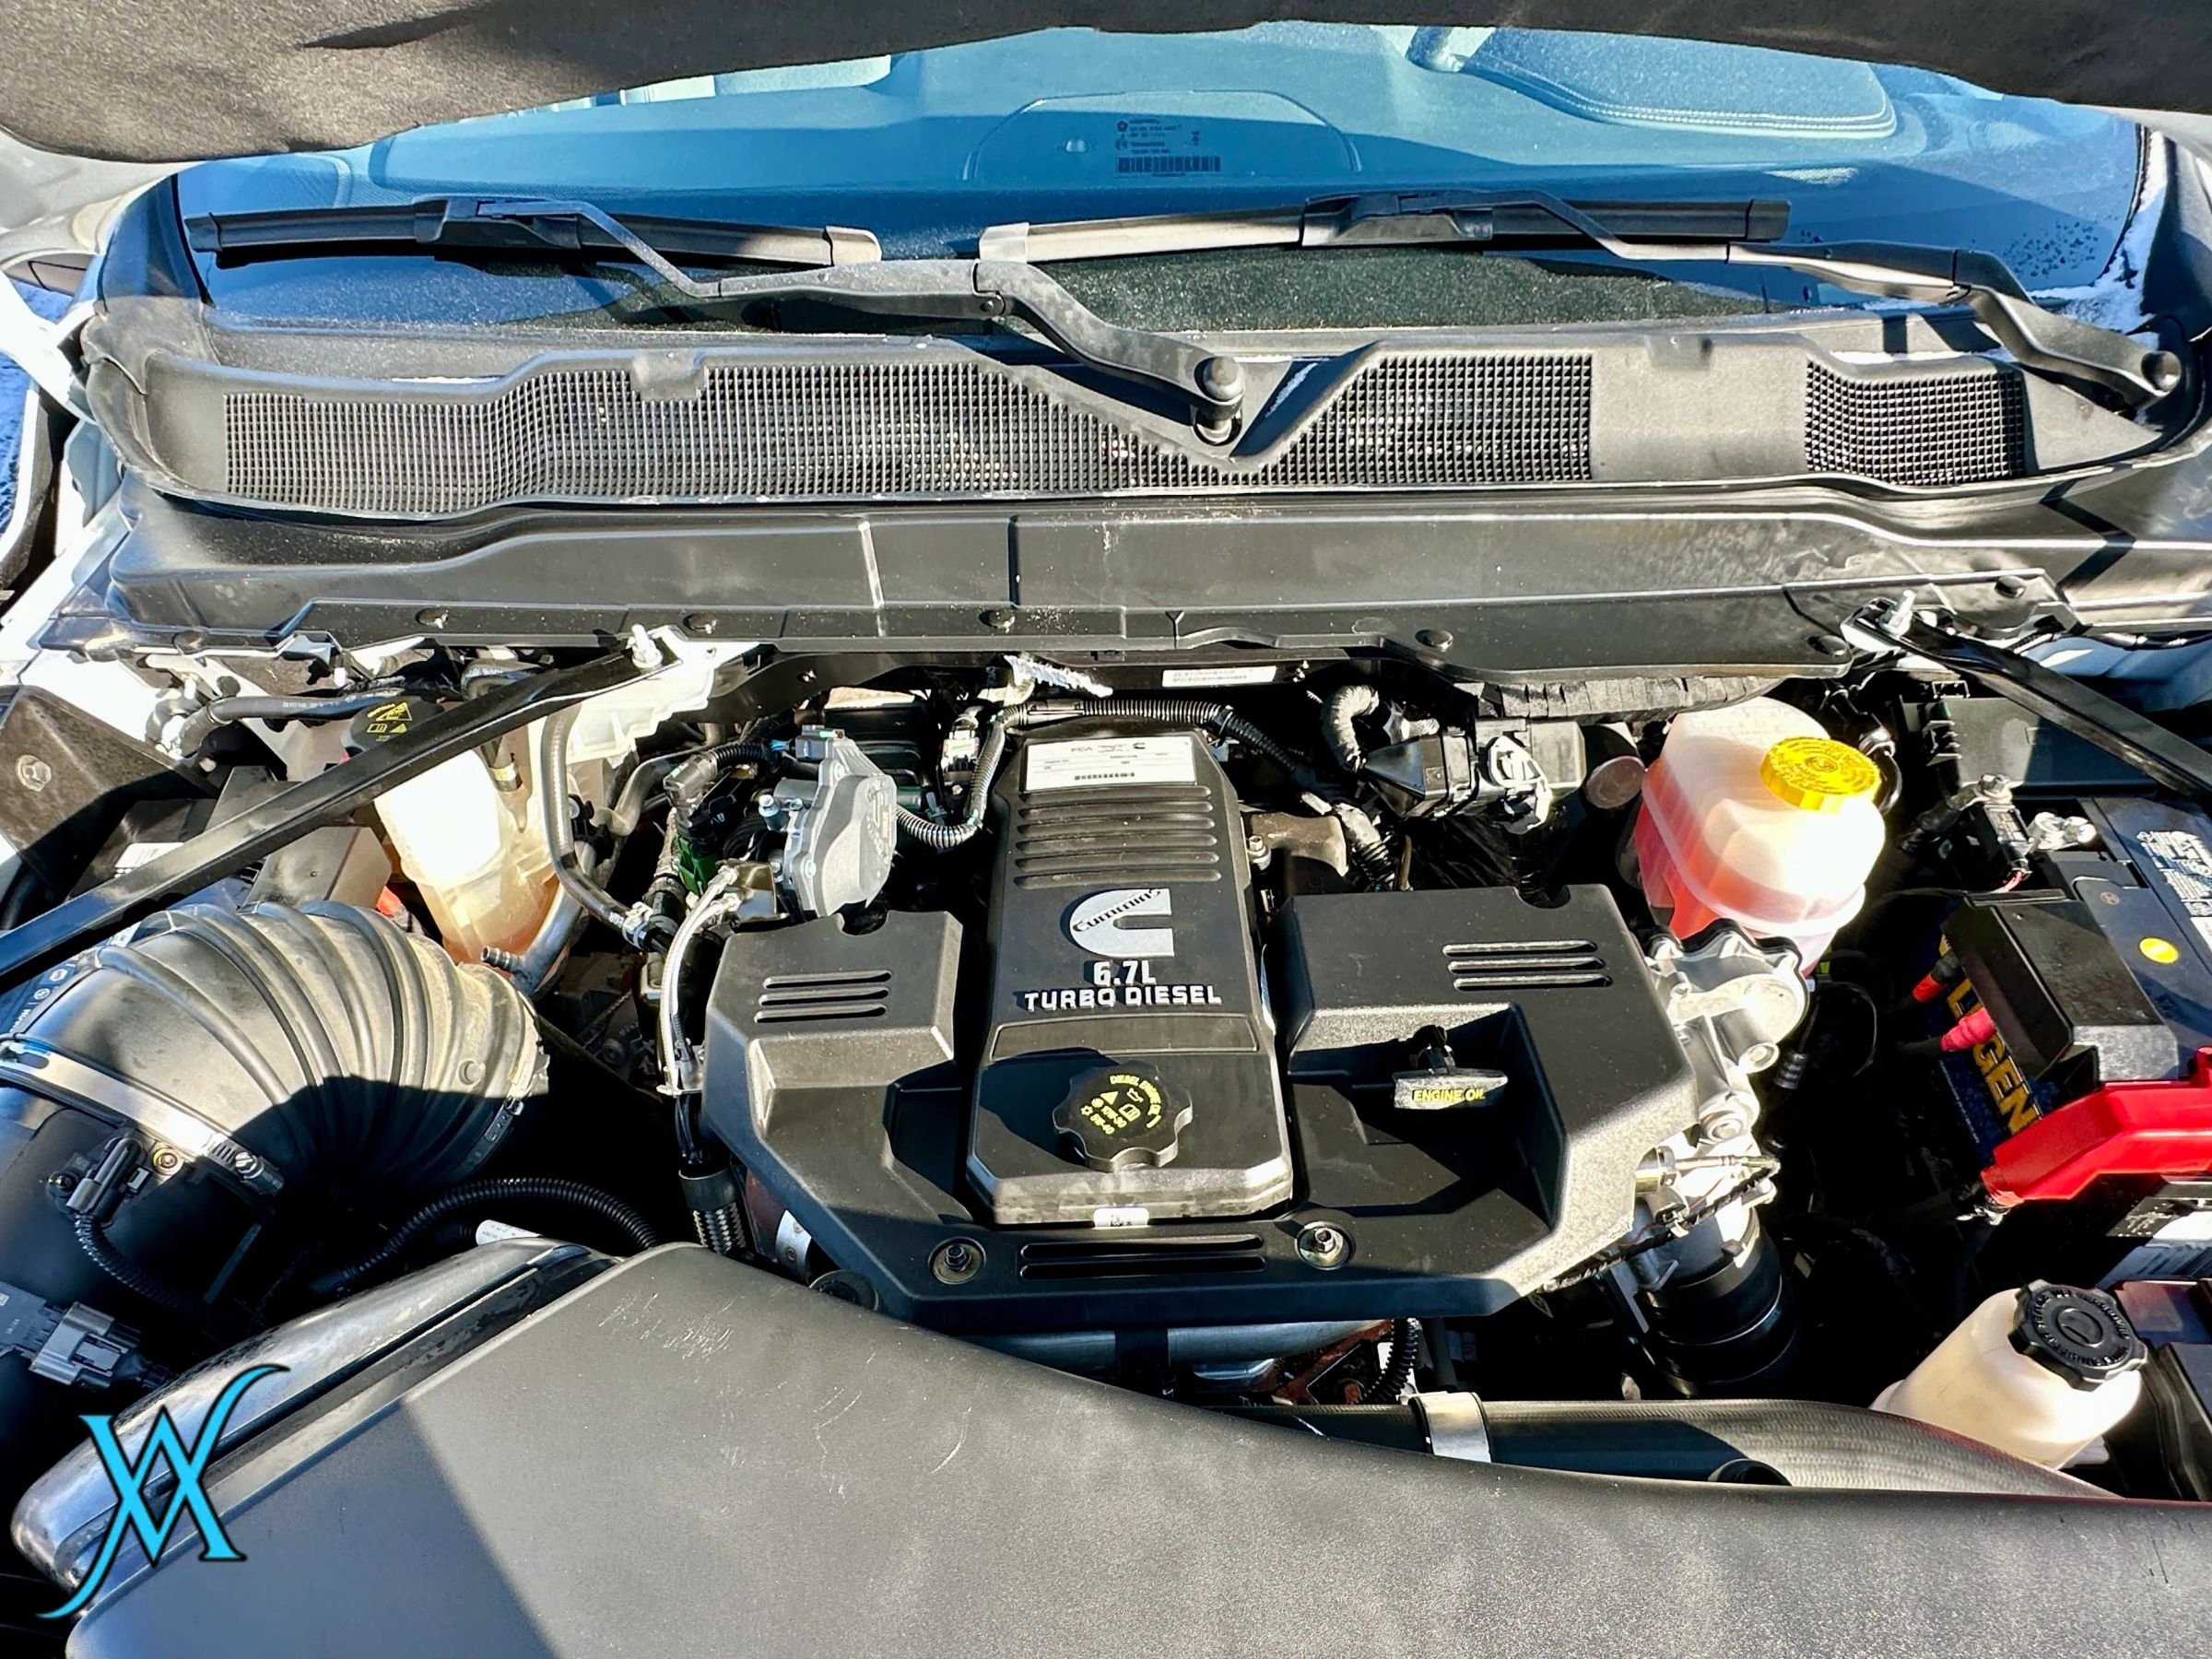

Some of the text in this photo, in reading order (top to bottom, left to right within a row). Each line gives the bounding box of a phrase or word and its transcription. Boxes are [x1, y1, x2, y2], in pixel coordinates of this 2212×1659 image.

[1071, 888, 1161, 933] Cummins
[1093, 960, 1157, 986] 6.7L
[1024, 985, 1222, 1011] TURBO DIESEL
[1413, 1088, 1486, 1102] ENGINE OIL
